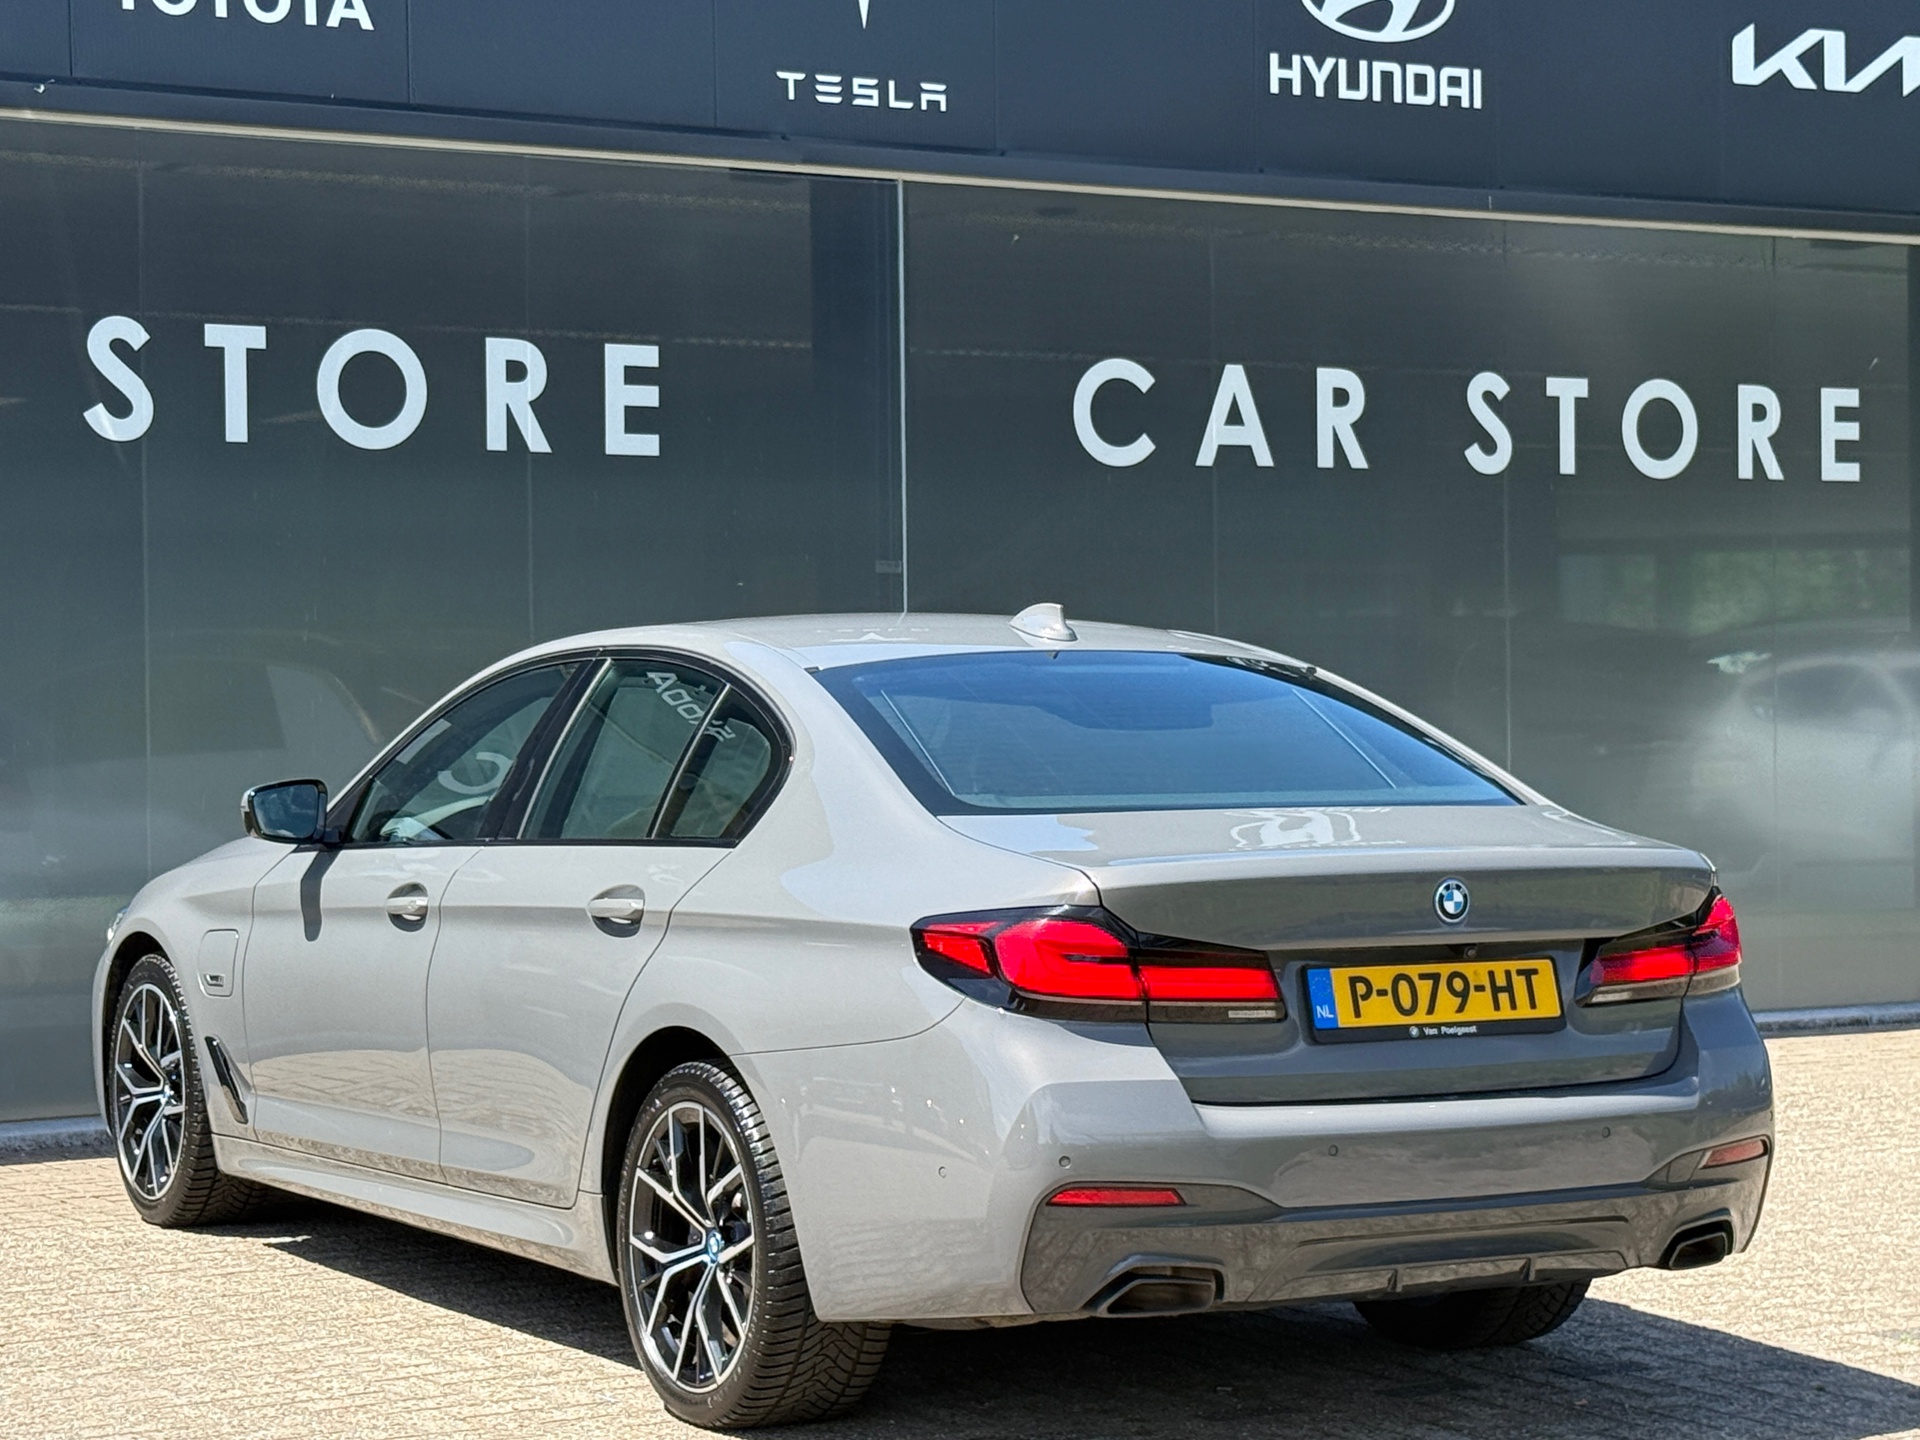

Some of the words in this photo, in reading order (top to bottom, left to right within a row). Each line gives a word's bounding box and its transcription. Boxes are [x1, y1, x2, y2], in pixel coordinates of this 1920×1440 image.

[1269, 52, 1482, 109] HYUNDAI
[1732, 23, 1920, 97] KIA
[776, 71, 947, 112] TESLA
[83, 315, 660, 457] STORE
[1073, 358, 1369, 469] CAR
[1464, 371, 1861, 482] STORE
[1316, 1004, 1334, 1019] NL
[1347, 968, 1539, 1018] P-079-HT
